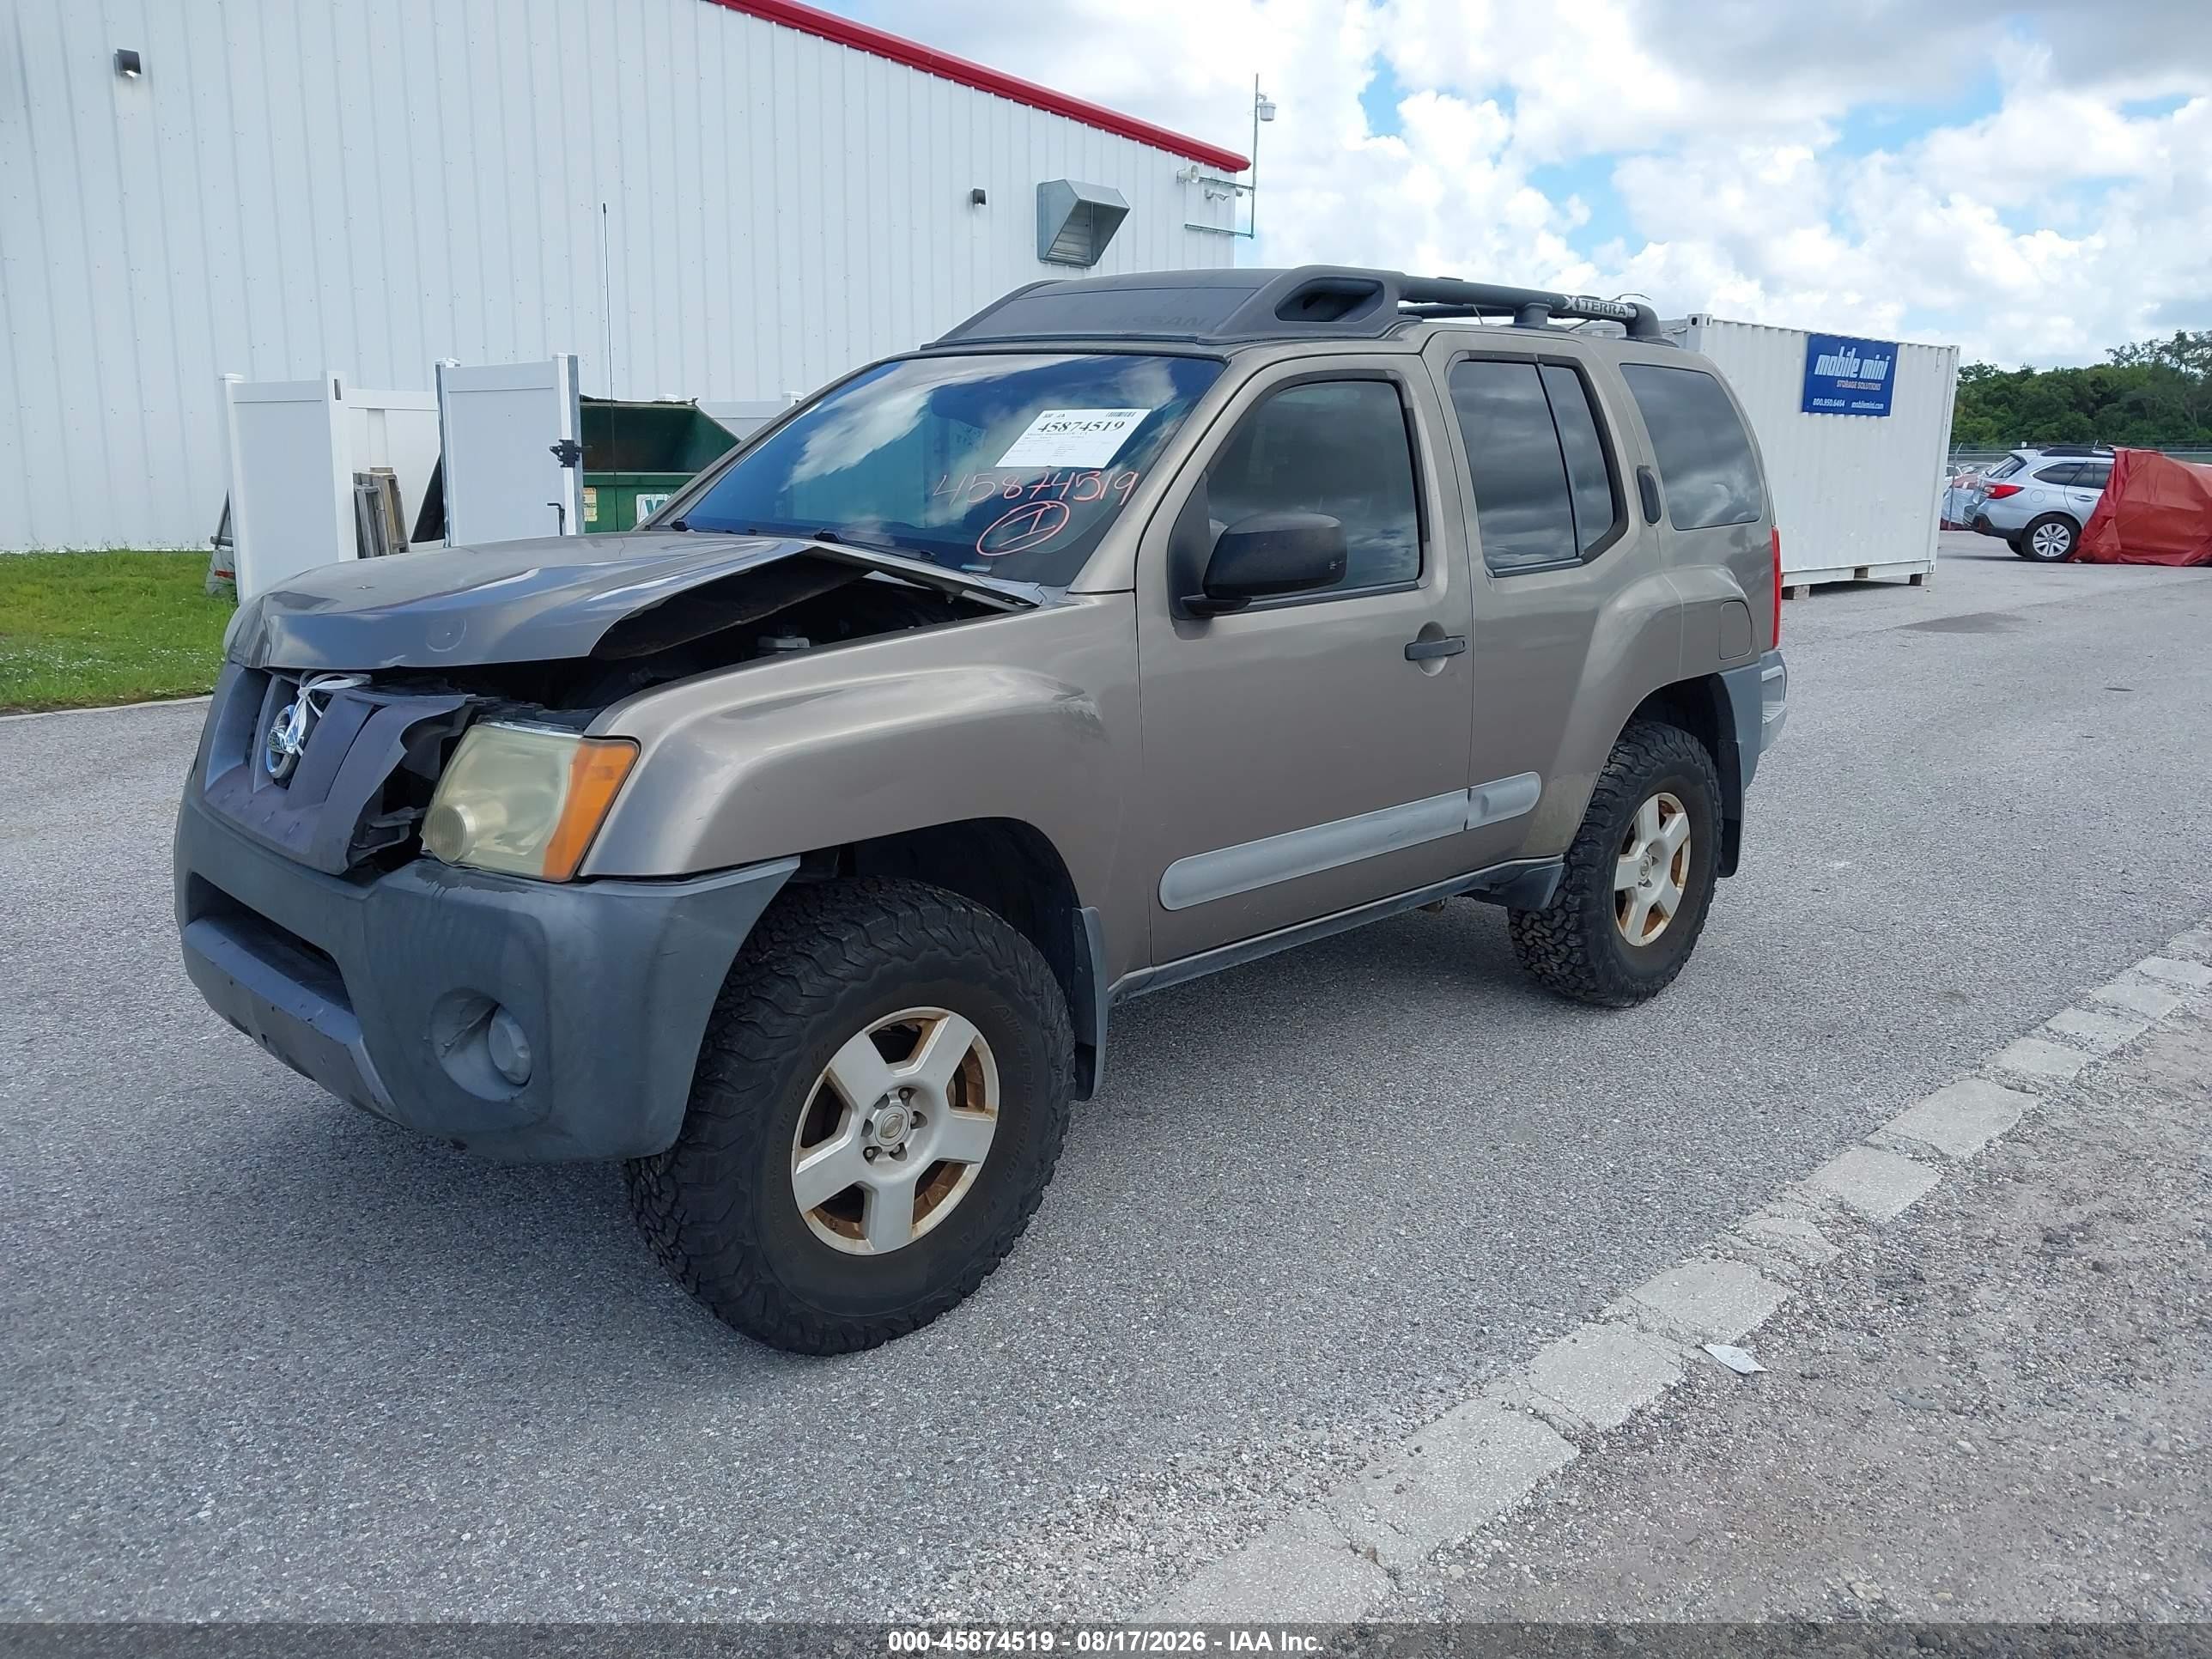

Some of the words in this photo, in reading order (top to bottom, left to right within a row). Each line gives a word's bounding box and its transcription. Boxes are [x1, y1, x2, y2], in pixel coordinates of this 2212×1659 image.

[1563, 295, 1627, 317] XTERRA
[1814, 346, 1861, 378] mobile
[1859, 354, 1891, 380] mini
[1837, 380, 1857, 389] STORAGE
[1857, 381, 1881, 391] SOLUTIONS
[1036, 421, 1126, 433] 45874519
[933, 471, 1139, 507] 45874519
